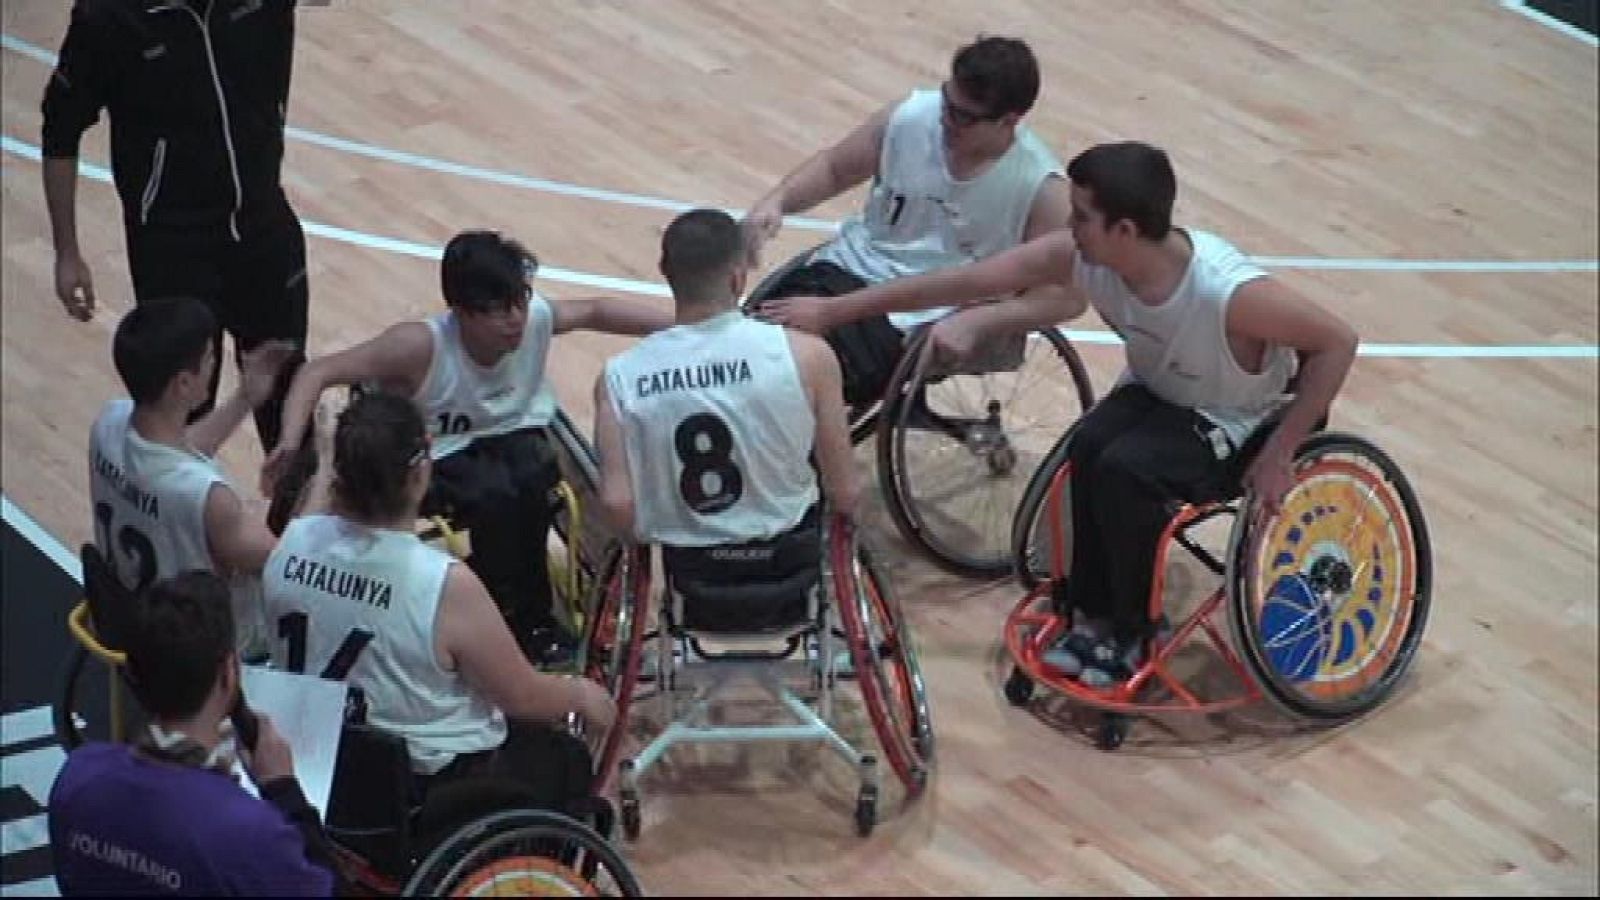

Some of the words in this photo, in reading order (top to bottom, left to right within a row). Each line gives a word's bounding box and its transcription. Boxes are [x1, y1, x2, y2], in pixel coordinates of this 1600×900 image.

[636, 358, 753, 397] CATALUNYA
[674, 412, 743, 516] 8
[283, 554, 392, 610] CATALUNYA
